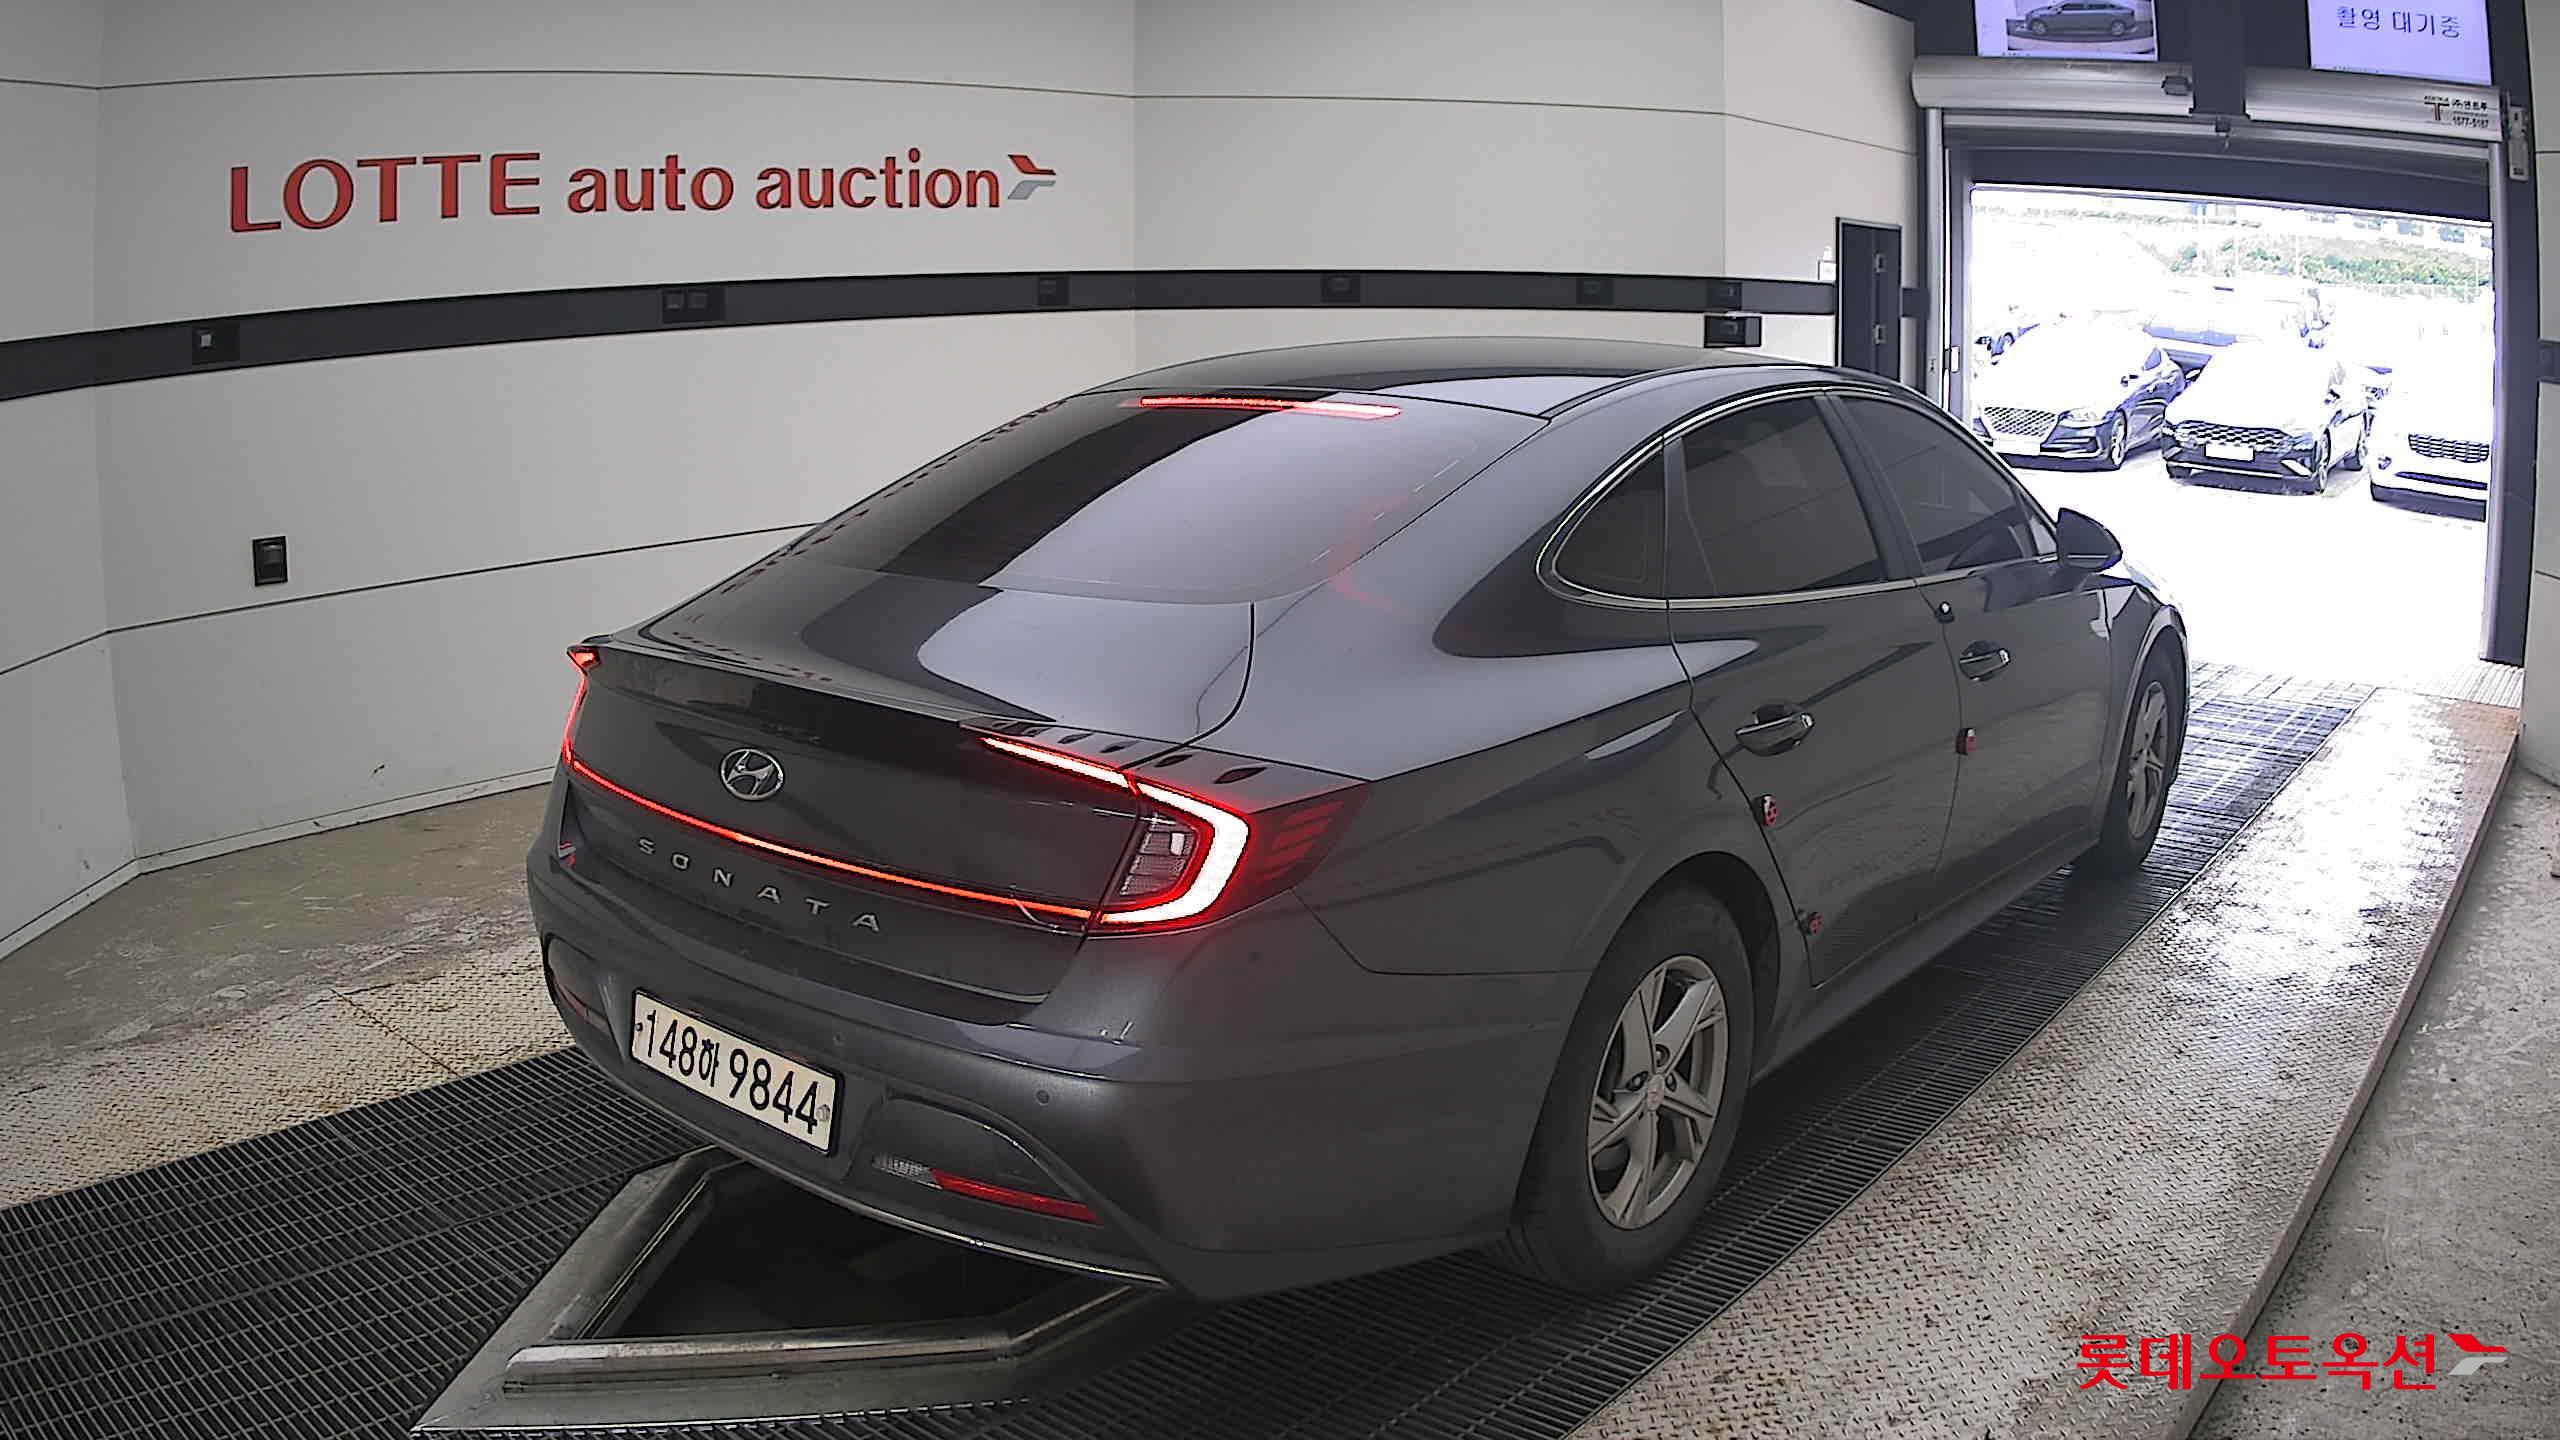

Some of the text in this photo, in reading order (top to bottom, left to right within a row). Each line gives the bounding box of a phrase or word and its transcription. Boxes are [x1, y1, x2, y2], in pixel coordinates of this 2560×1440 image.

[2337, 6, 2460, 38] 촬영 대기중
[230, 147, 1001, 233] LOTTE auto auction
[637, 837, 881, 933] SONATA
[647, 1009, 819, 1136] 148하 9844
